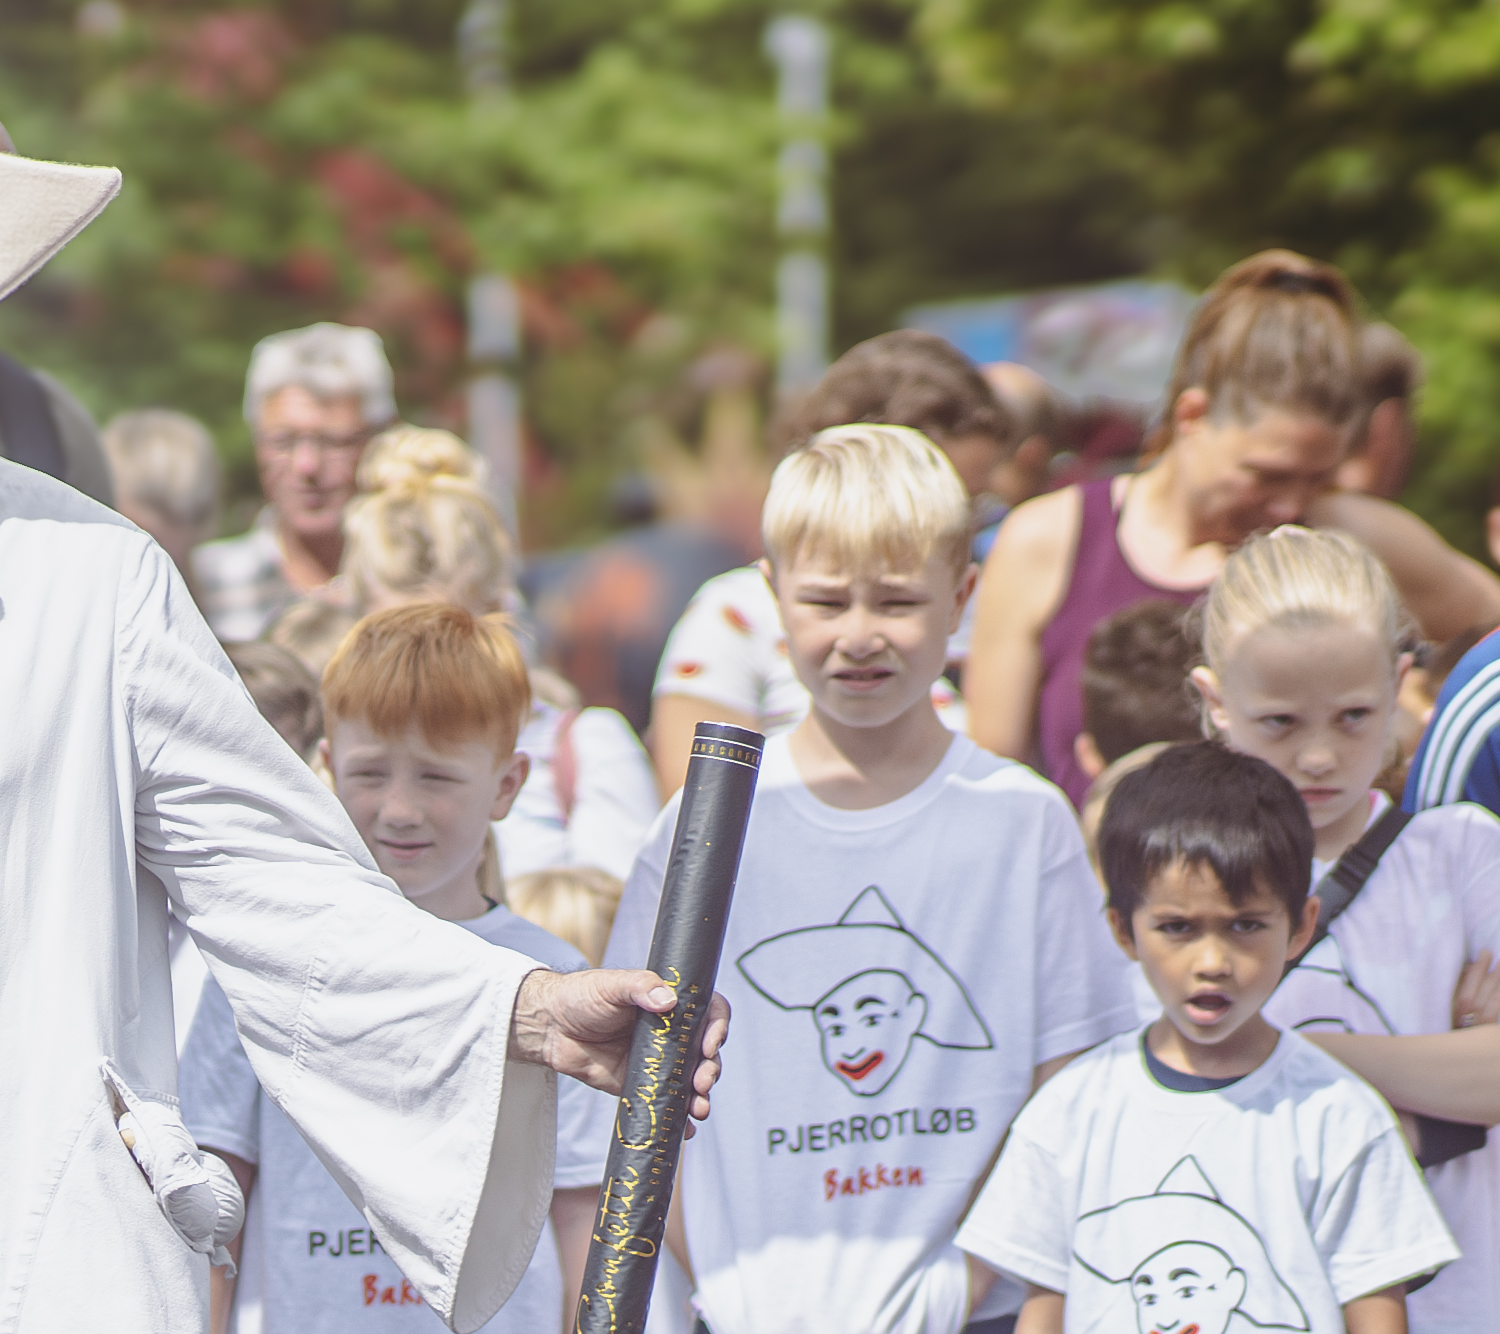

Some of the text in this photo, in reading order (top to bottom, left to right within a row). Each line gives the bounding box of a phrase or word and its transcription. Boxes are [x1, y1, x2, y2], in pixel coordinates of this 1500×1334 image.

[616, 966, 681, 1151] Cann
[767, 1107, 977, 1156] PJERROTLØB
[823, 1163, 923, 1203] Bakken
[308, 1228, 390, 1258] PJER
[362, 1274, 424, 1307] Bak
